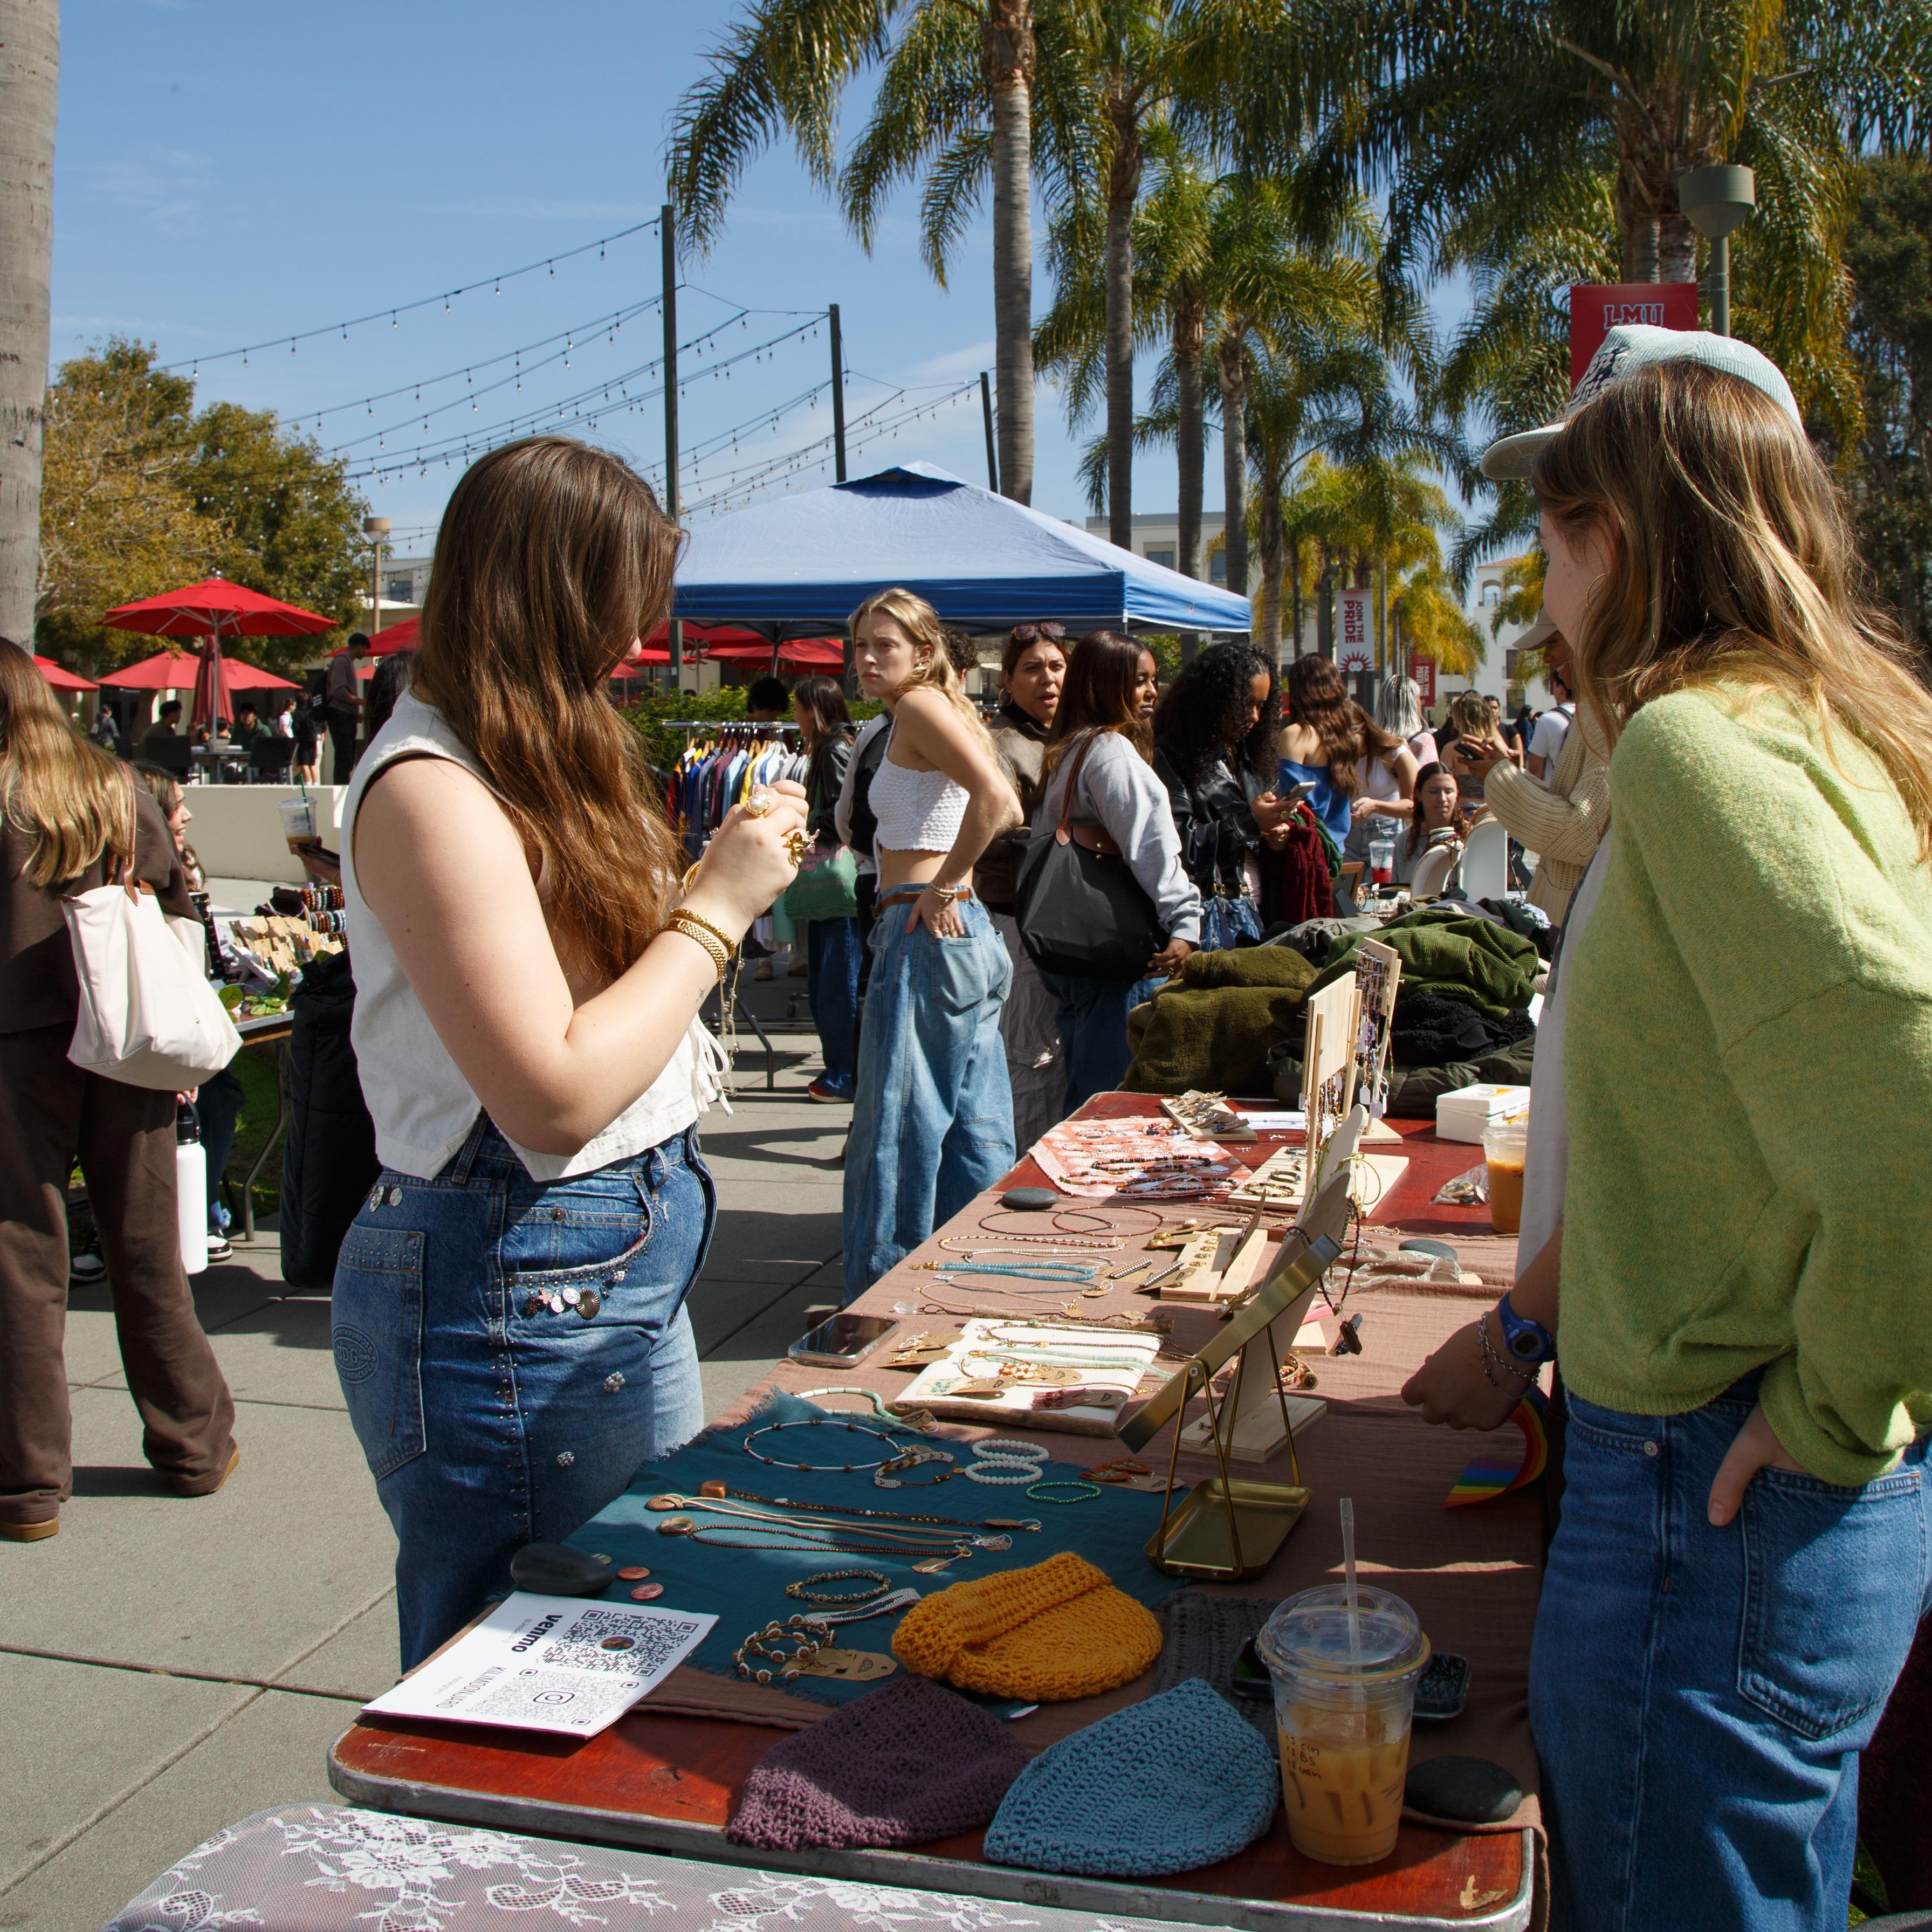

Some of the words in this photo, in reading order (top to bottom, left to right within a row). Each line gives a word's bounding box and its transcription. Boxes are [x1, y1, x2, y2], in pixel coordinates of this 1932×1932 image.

[1604, 303, 1665, 331] LMU
[1344, 600, 1356, 644] PRIDE
[336, 1345, 358, 1364] BDG
[511, 1614, 563, 1653] venmo
[436, 1666, 507, 1709] KILIMOONJARO
